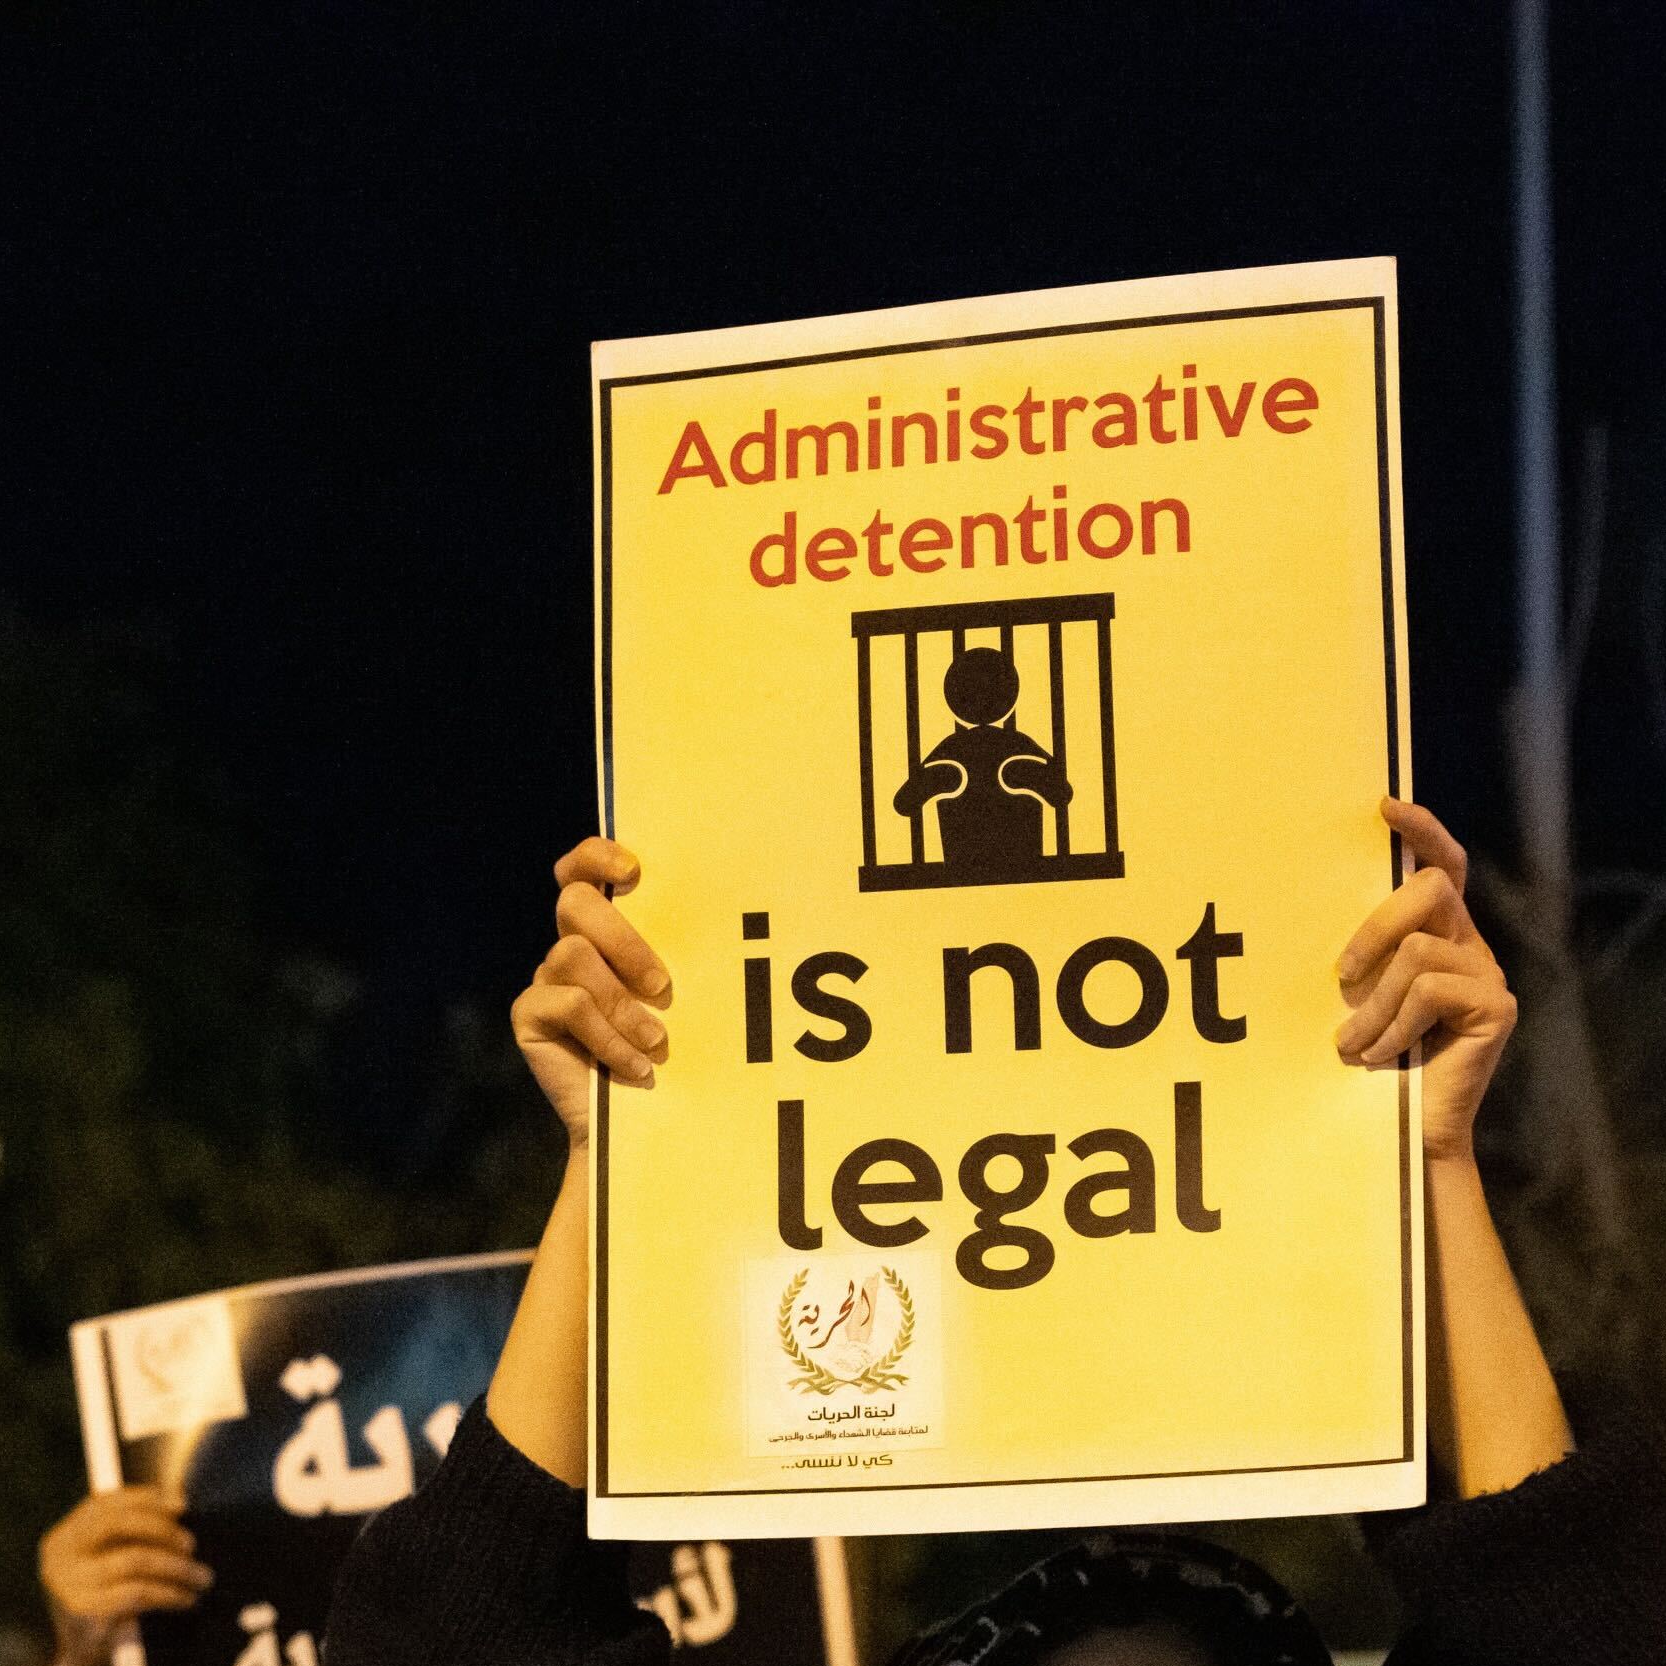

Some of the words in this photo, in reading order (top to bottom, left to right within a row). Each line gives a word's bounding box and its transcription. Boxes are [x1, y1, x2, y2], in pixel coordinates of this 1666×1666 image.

[658, 363, 1320, 496] Administrative
[749, 484, 1191, 588] detention
[742, 911, 873, 1064] is
[942, 902, 1247, 1054] not
[777, 1081, 1221, 1290] legal
[807, 1405, 860, 1423] الحريات
[847, 1455, 858, 1467] لا
[864, 1403, 895, 1421] لجنة
